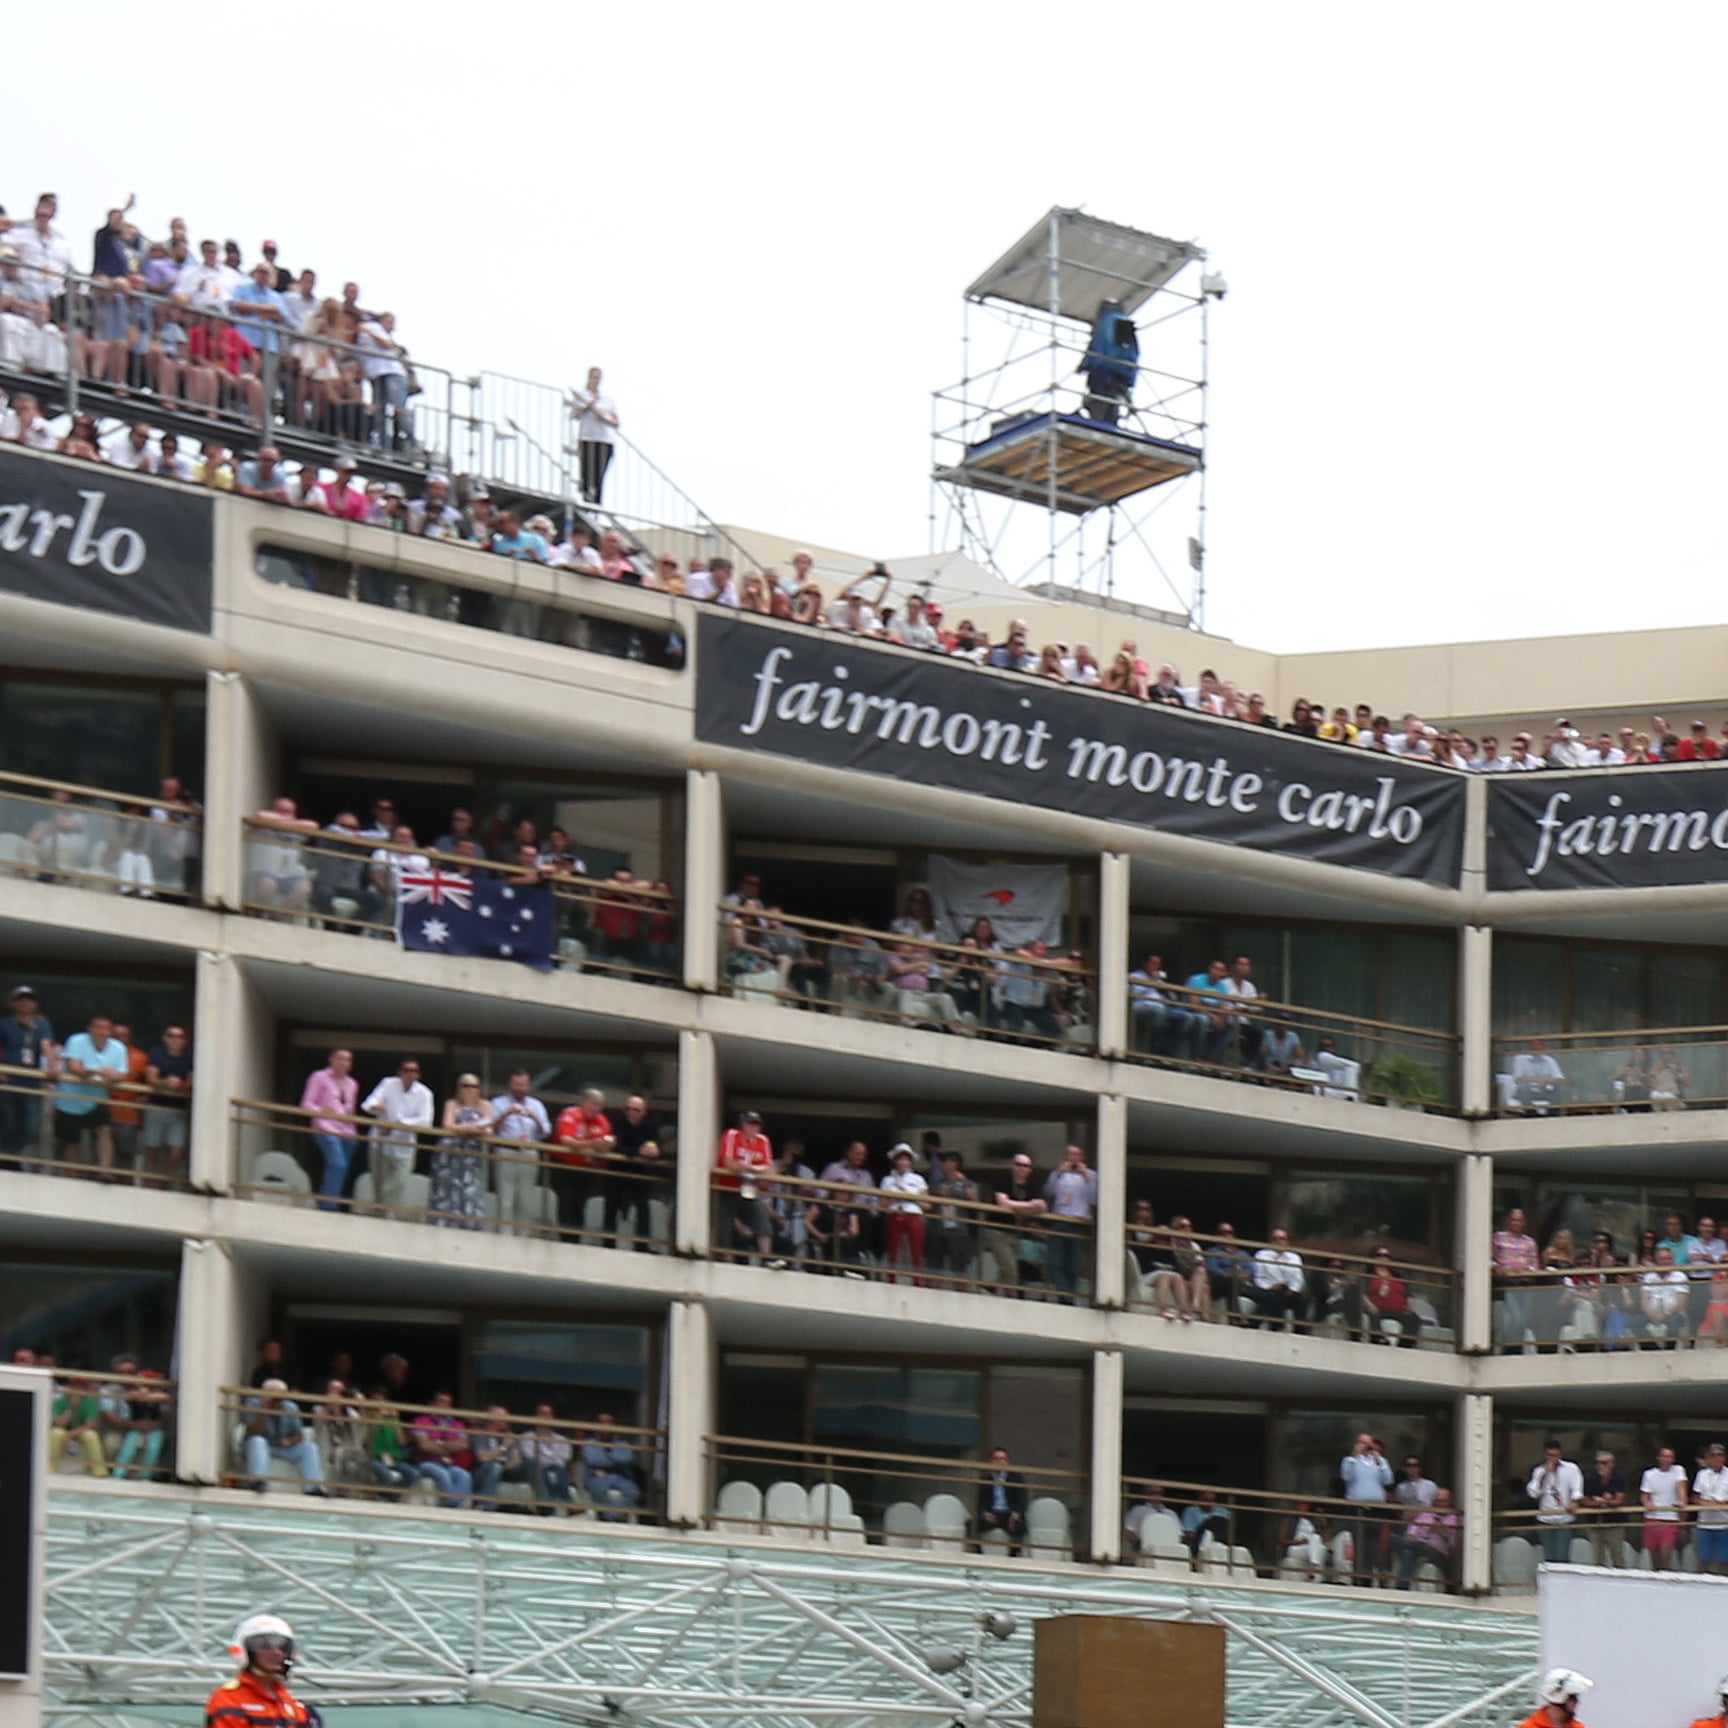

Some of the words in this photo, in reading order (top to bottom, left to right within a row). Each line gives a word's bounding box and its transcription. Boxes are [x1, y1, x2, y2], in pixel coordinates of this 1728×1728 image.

[740, 646, 1052, 771] fairmont
[1066, 736, 1263, 815] monte
[1276, 777, 1424, 845] carlo
